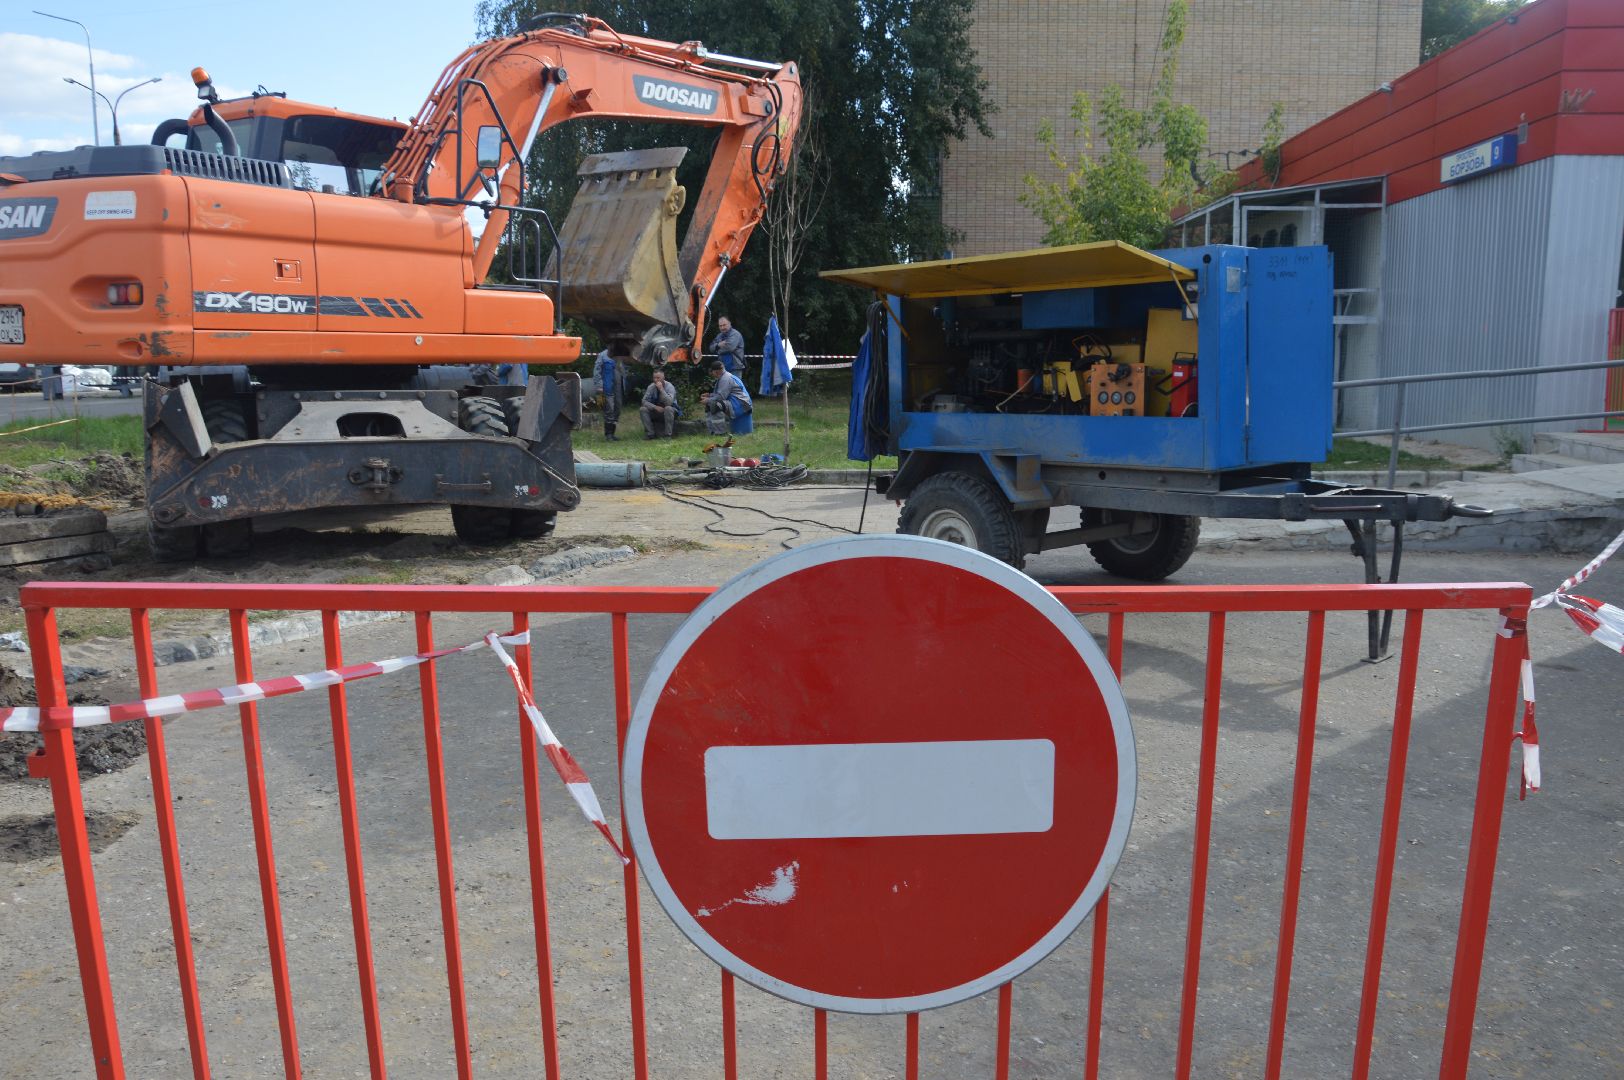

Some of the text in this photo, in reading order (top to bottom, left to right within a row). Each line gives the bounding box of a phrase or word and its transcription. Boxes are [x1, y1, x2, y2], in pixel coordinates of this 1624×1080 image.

[642, 81, 713, 110] DOOSAN
[1493, 145, 1500, 160] 9
[1450, 155, 1485, 177] БОРЗОВА
